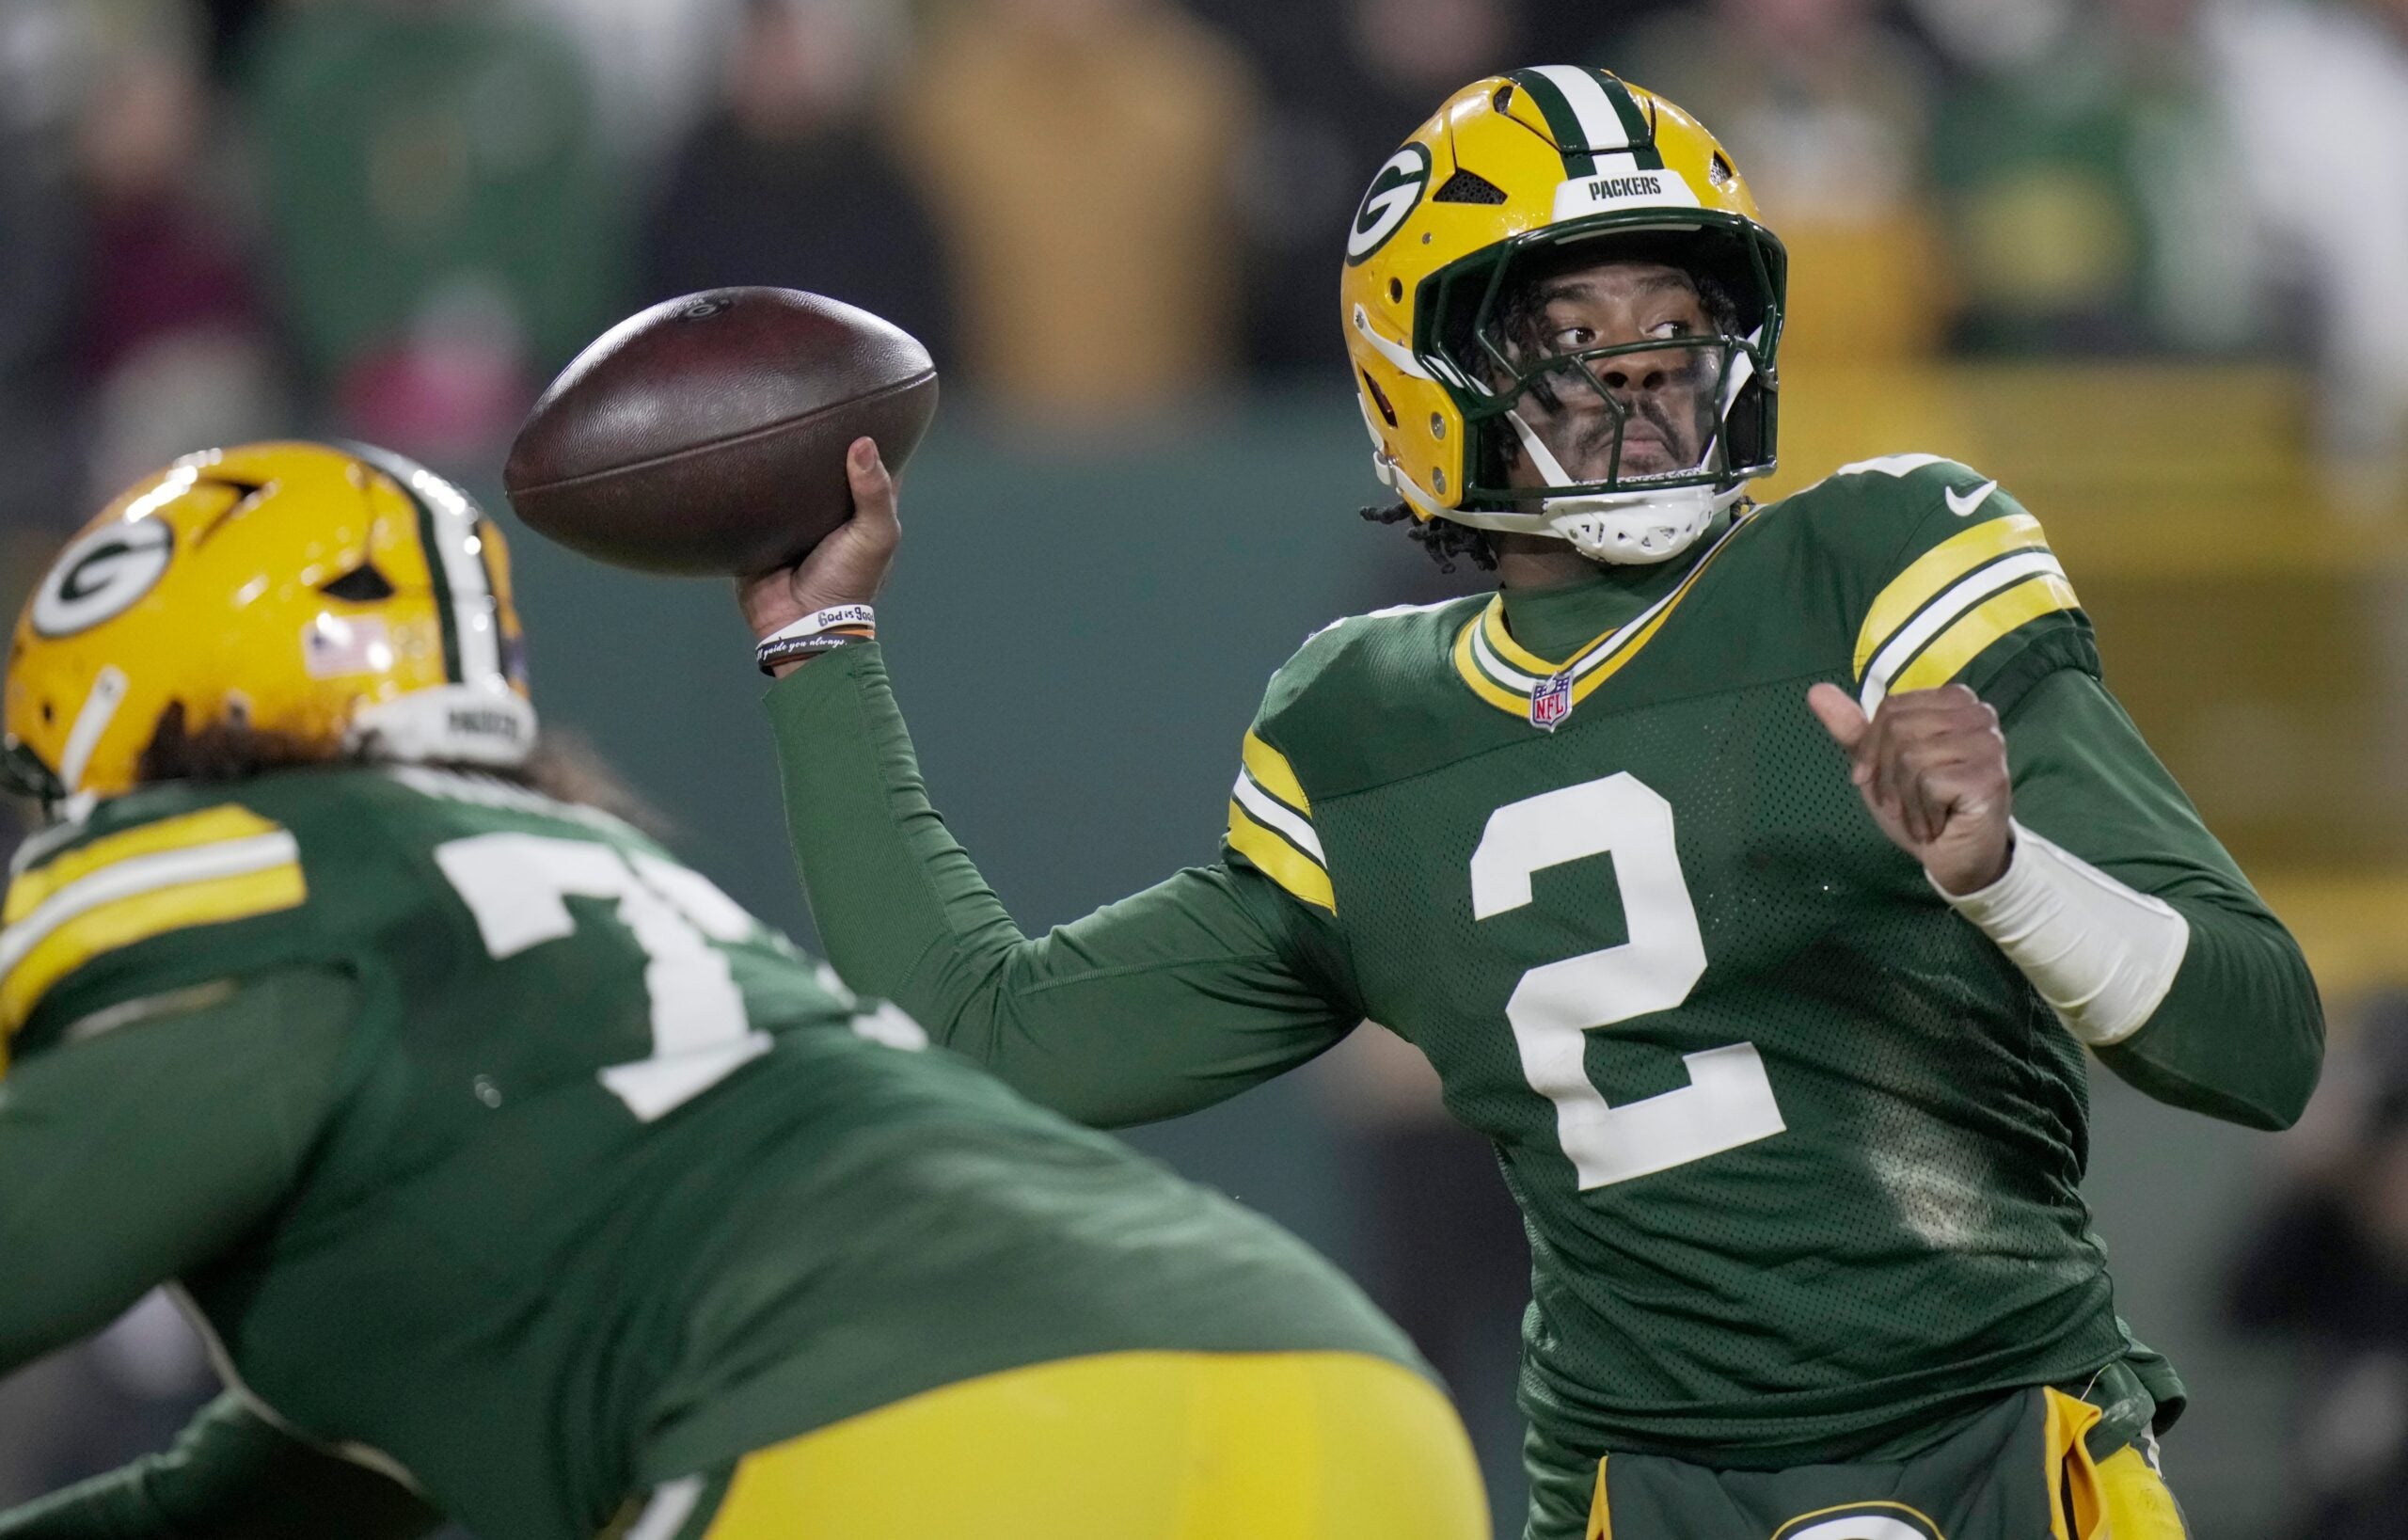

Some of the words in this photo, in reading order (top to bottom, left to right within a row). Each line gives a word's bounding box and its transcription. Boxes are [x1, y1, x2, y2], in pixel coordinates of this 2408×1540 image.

[1348, 149, 1424, 256] G
[1588, 176, 1662, 200] PACKERS
[32, 516, 167, 637] G
[817, 611, 843, 627] God
[844, 611, 854, 619] is
[788, 641, 807, 654] you
[1535, 691, 1565, 721] NFL
[1469, 770, 1787, 1191] 2
